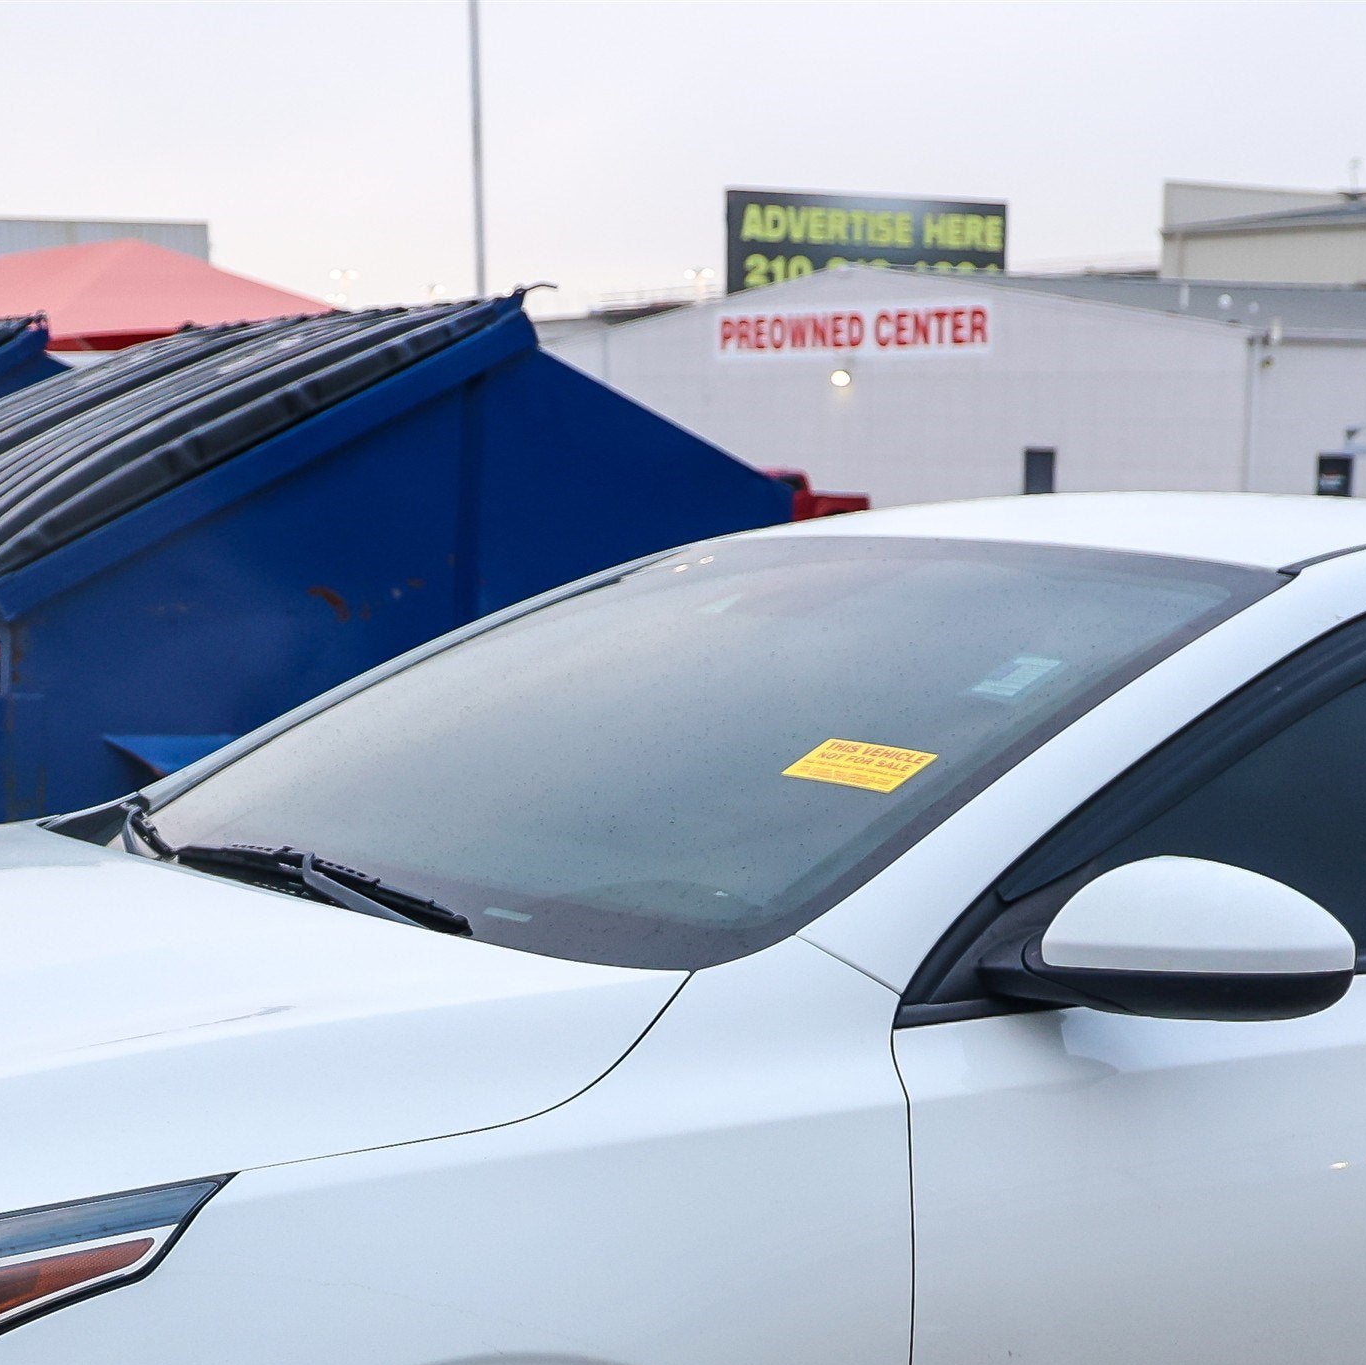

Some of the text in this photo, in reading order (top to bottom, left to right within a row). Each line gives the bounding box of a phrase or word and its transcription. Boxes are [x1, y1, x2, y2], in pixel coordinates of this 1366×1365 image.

[741, 203, 1004, 253] ADVERTISE HERE
[720, 304, 989, 350] PREOWNED CENTER
[817, 751, 843, 760] NOT
[845, 755, 873, 765] FOR
[875, 760, 913, 772] SALE
[825, 741, 929, 765] THIS VEHICLE
